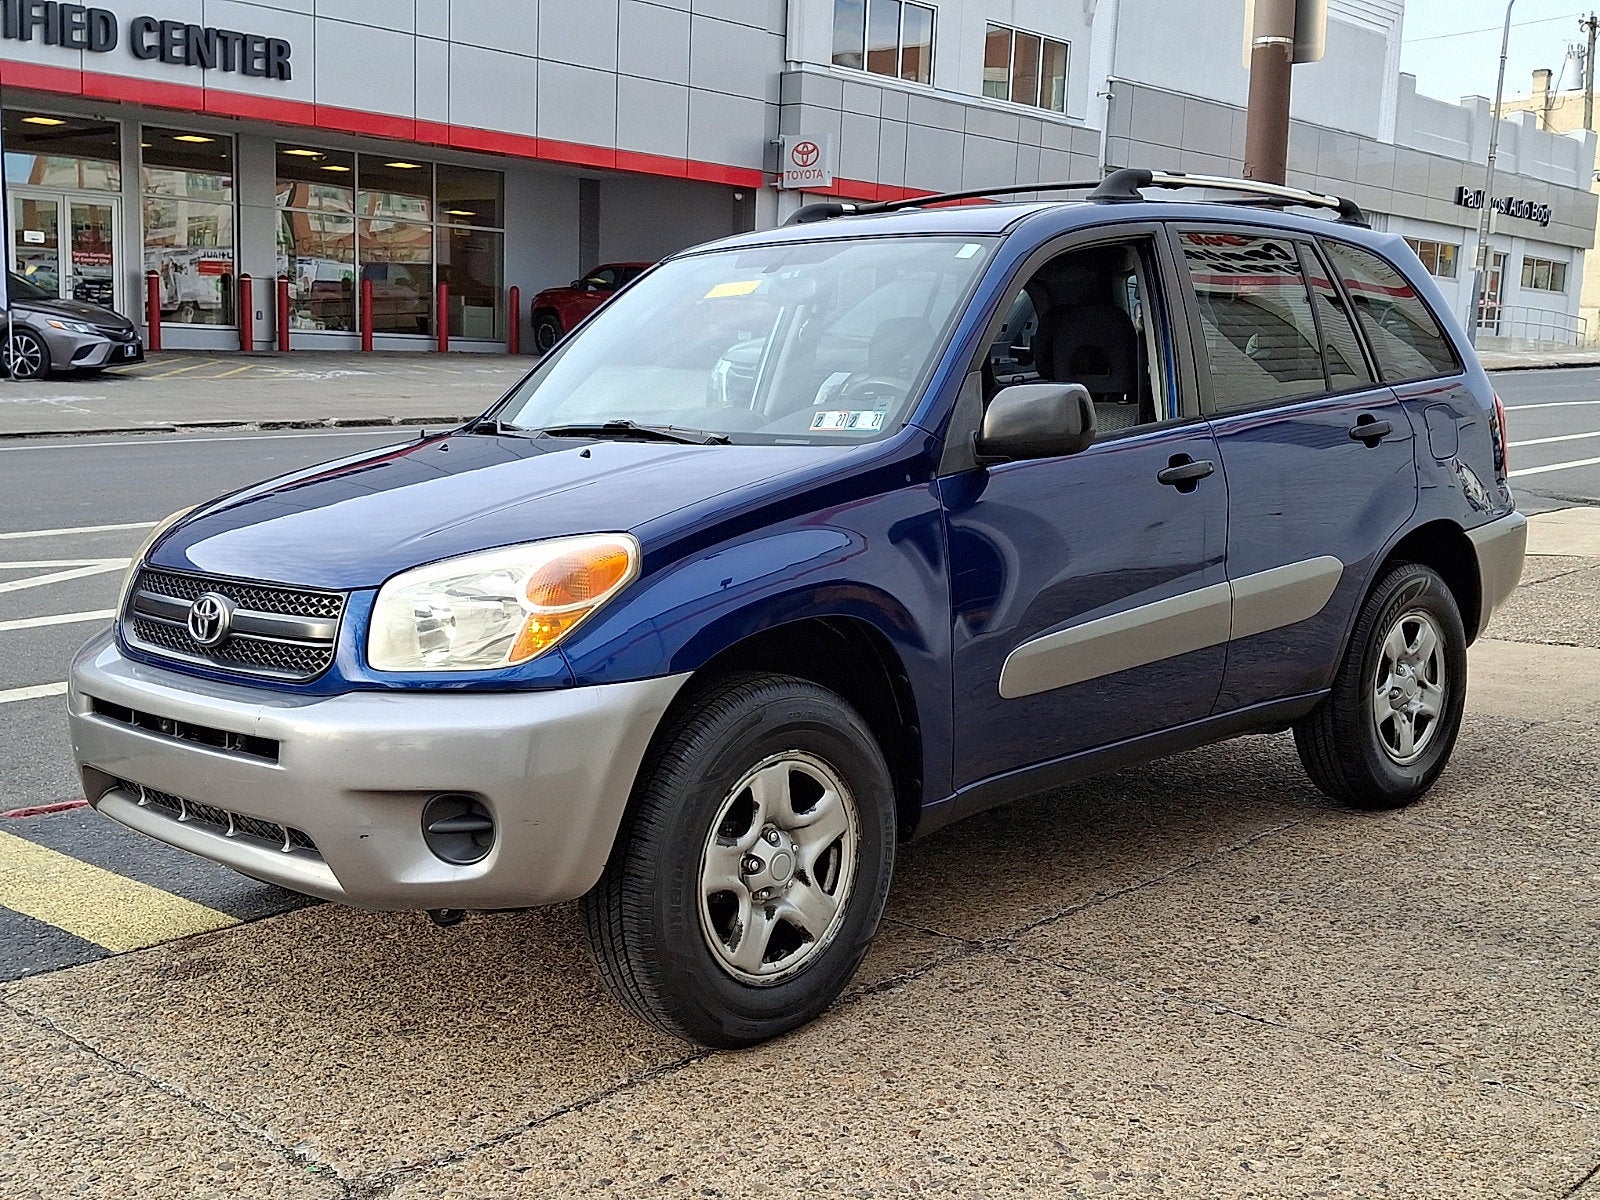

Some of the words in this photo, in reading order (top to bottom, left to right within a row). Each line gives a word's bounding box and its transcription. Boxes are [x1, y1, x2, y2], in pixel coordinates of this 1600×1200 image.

[130, 16, 292, 81] CENTER
[785, 169, 824, 180] TOYOTA
[1508, 197, 1530, 218] Auto
[1531, 202, 1552, 227] Body
[814, 416, 824, 427] 2
[835, 413, 847, 427] 27
[848, 416, 858, 427] 2
[871, 413, 883, 427] 27
